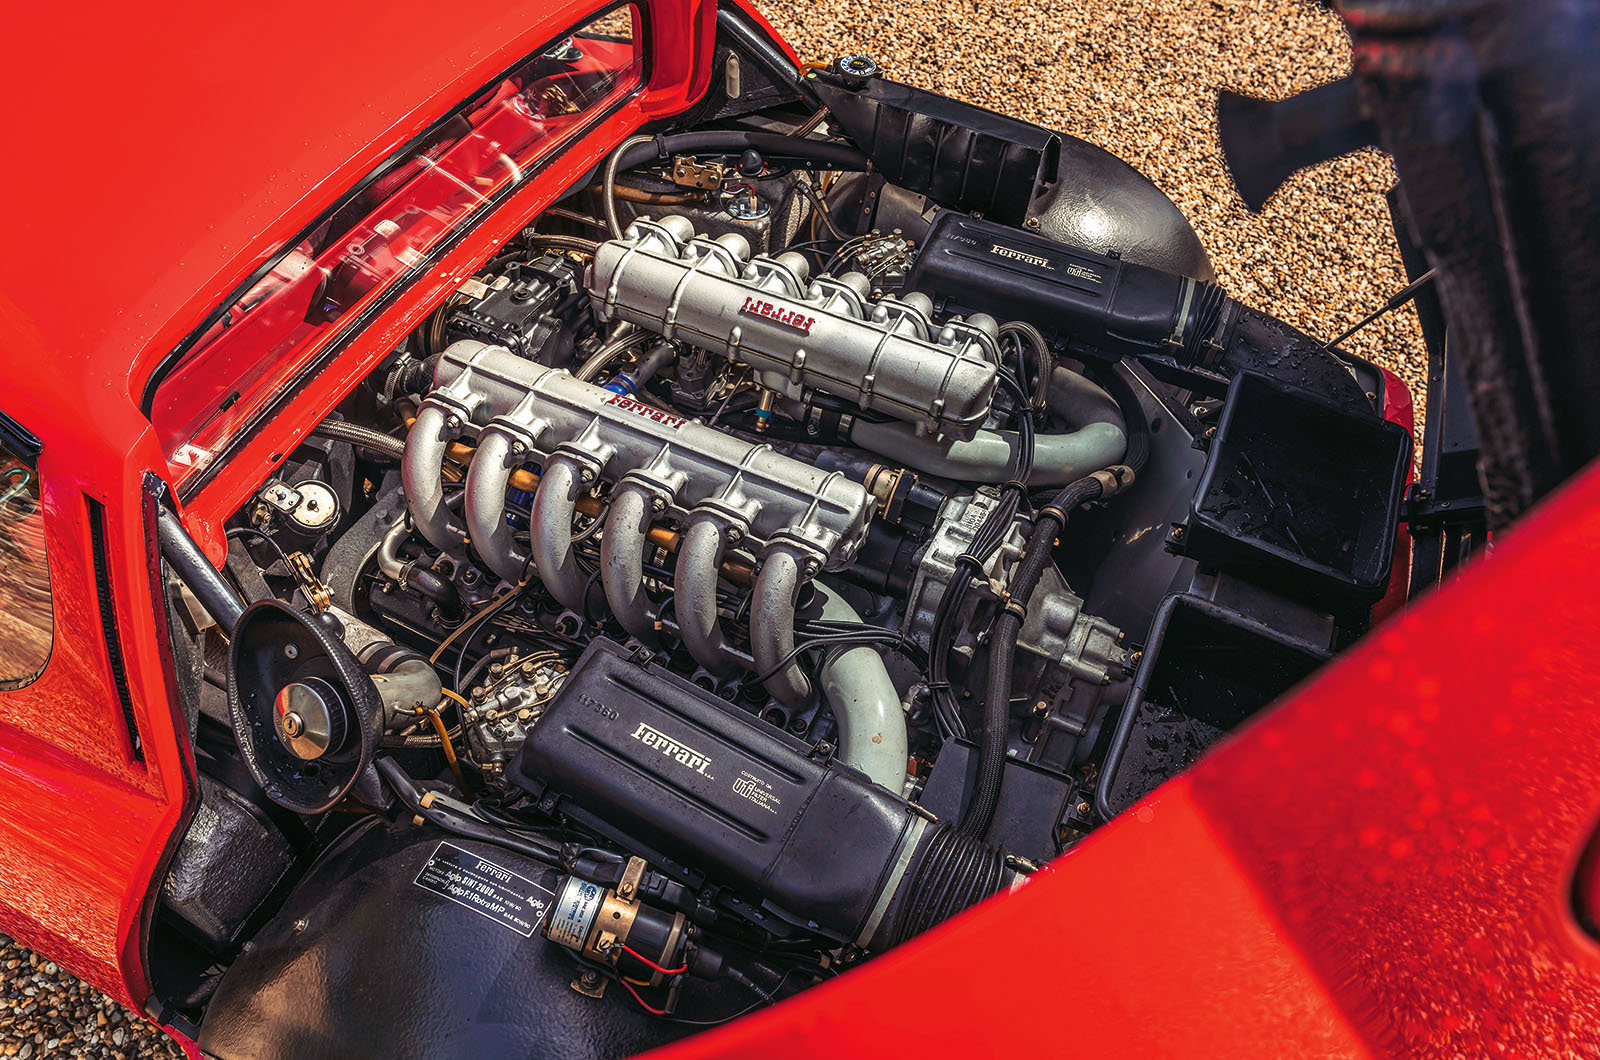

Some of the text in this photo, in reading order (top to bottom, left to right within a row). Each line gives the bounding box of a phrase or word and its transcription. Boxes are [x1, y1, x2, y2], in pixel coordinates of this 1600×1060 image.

[990, 244, 1049, 267] Ferrari
[741, 297, 815, 332] Ferrari
[605, 394, 687, 429] Ferrari
[630, 722, 712, 777] Ferrari
[754, 786, 781, 805] UNIVERSAL
[475, 860, 512, 883] Ferrari
[445, 870, 462, 882] Agip
[462, 876, 477, 889] SINT
[476, 882, 495, 897] 2000
[448, 884, 464, 896] Agip
[526, 896, 545, 909] Agip
